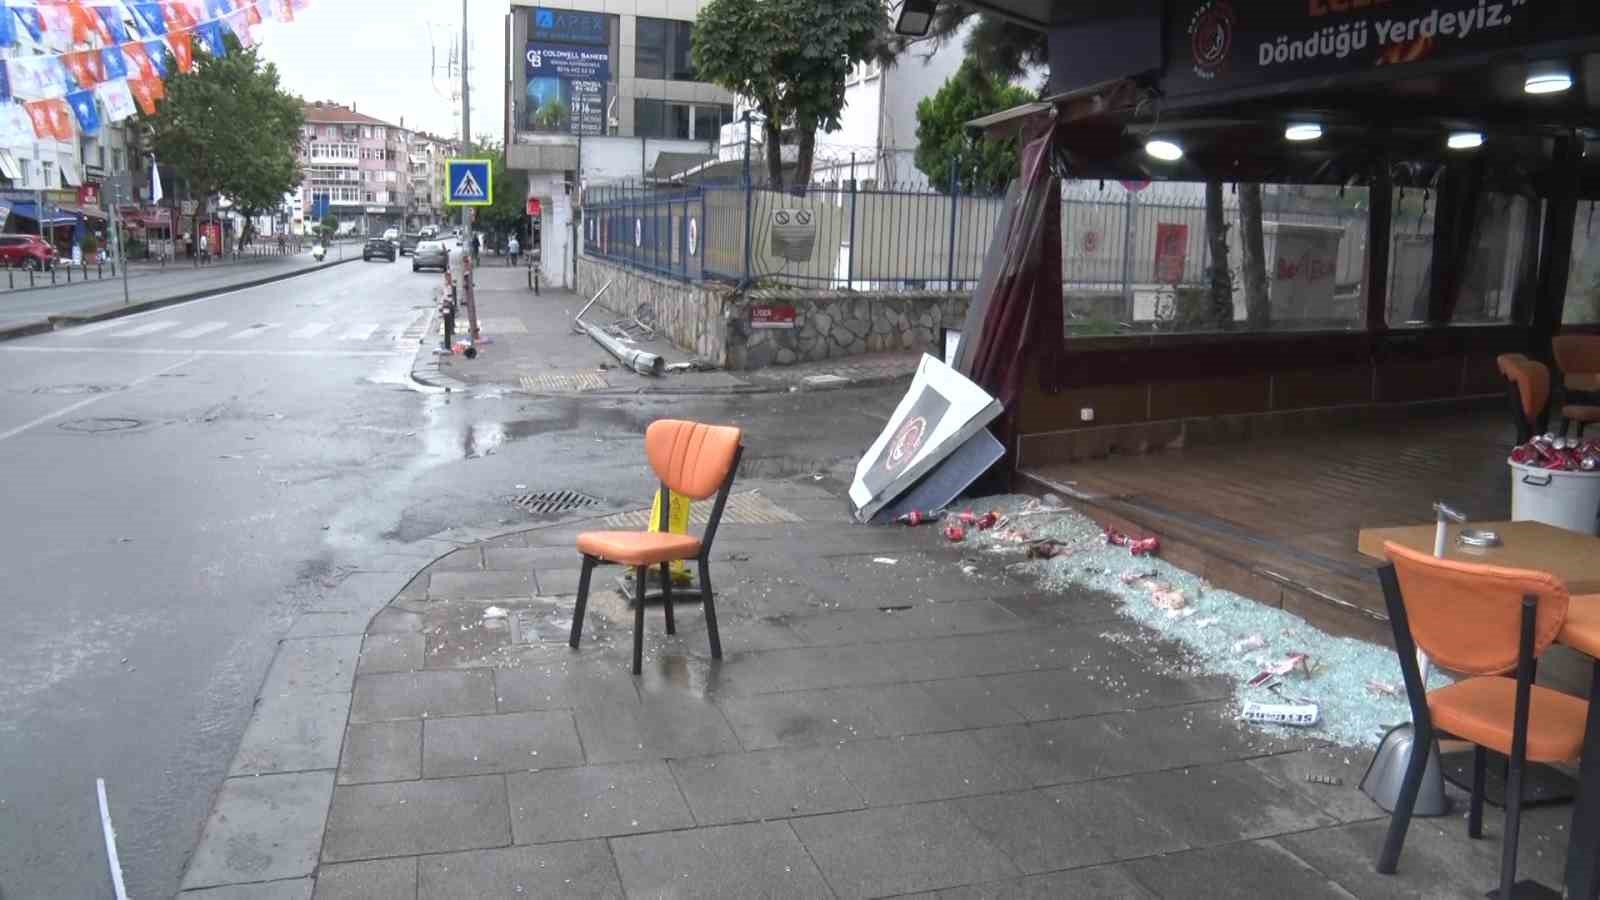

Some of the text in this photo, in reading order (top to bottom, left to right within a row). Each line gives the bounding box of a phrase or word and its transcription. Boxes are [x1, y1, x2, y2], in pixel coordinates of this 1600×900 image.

[542, 49, 608, 61] COLDWELL BANKER
[1258, 21, 1368, 65] Döndüğü
